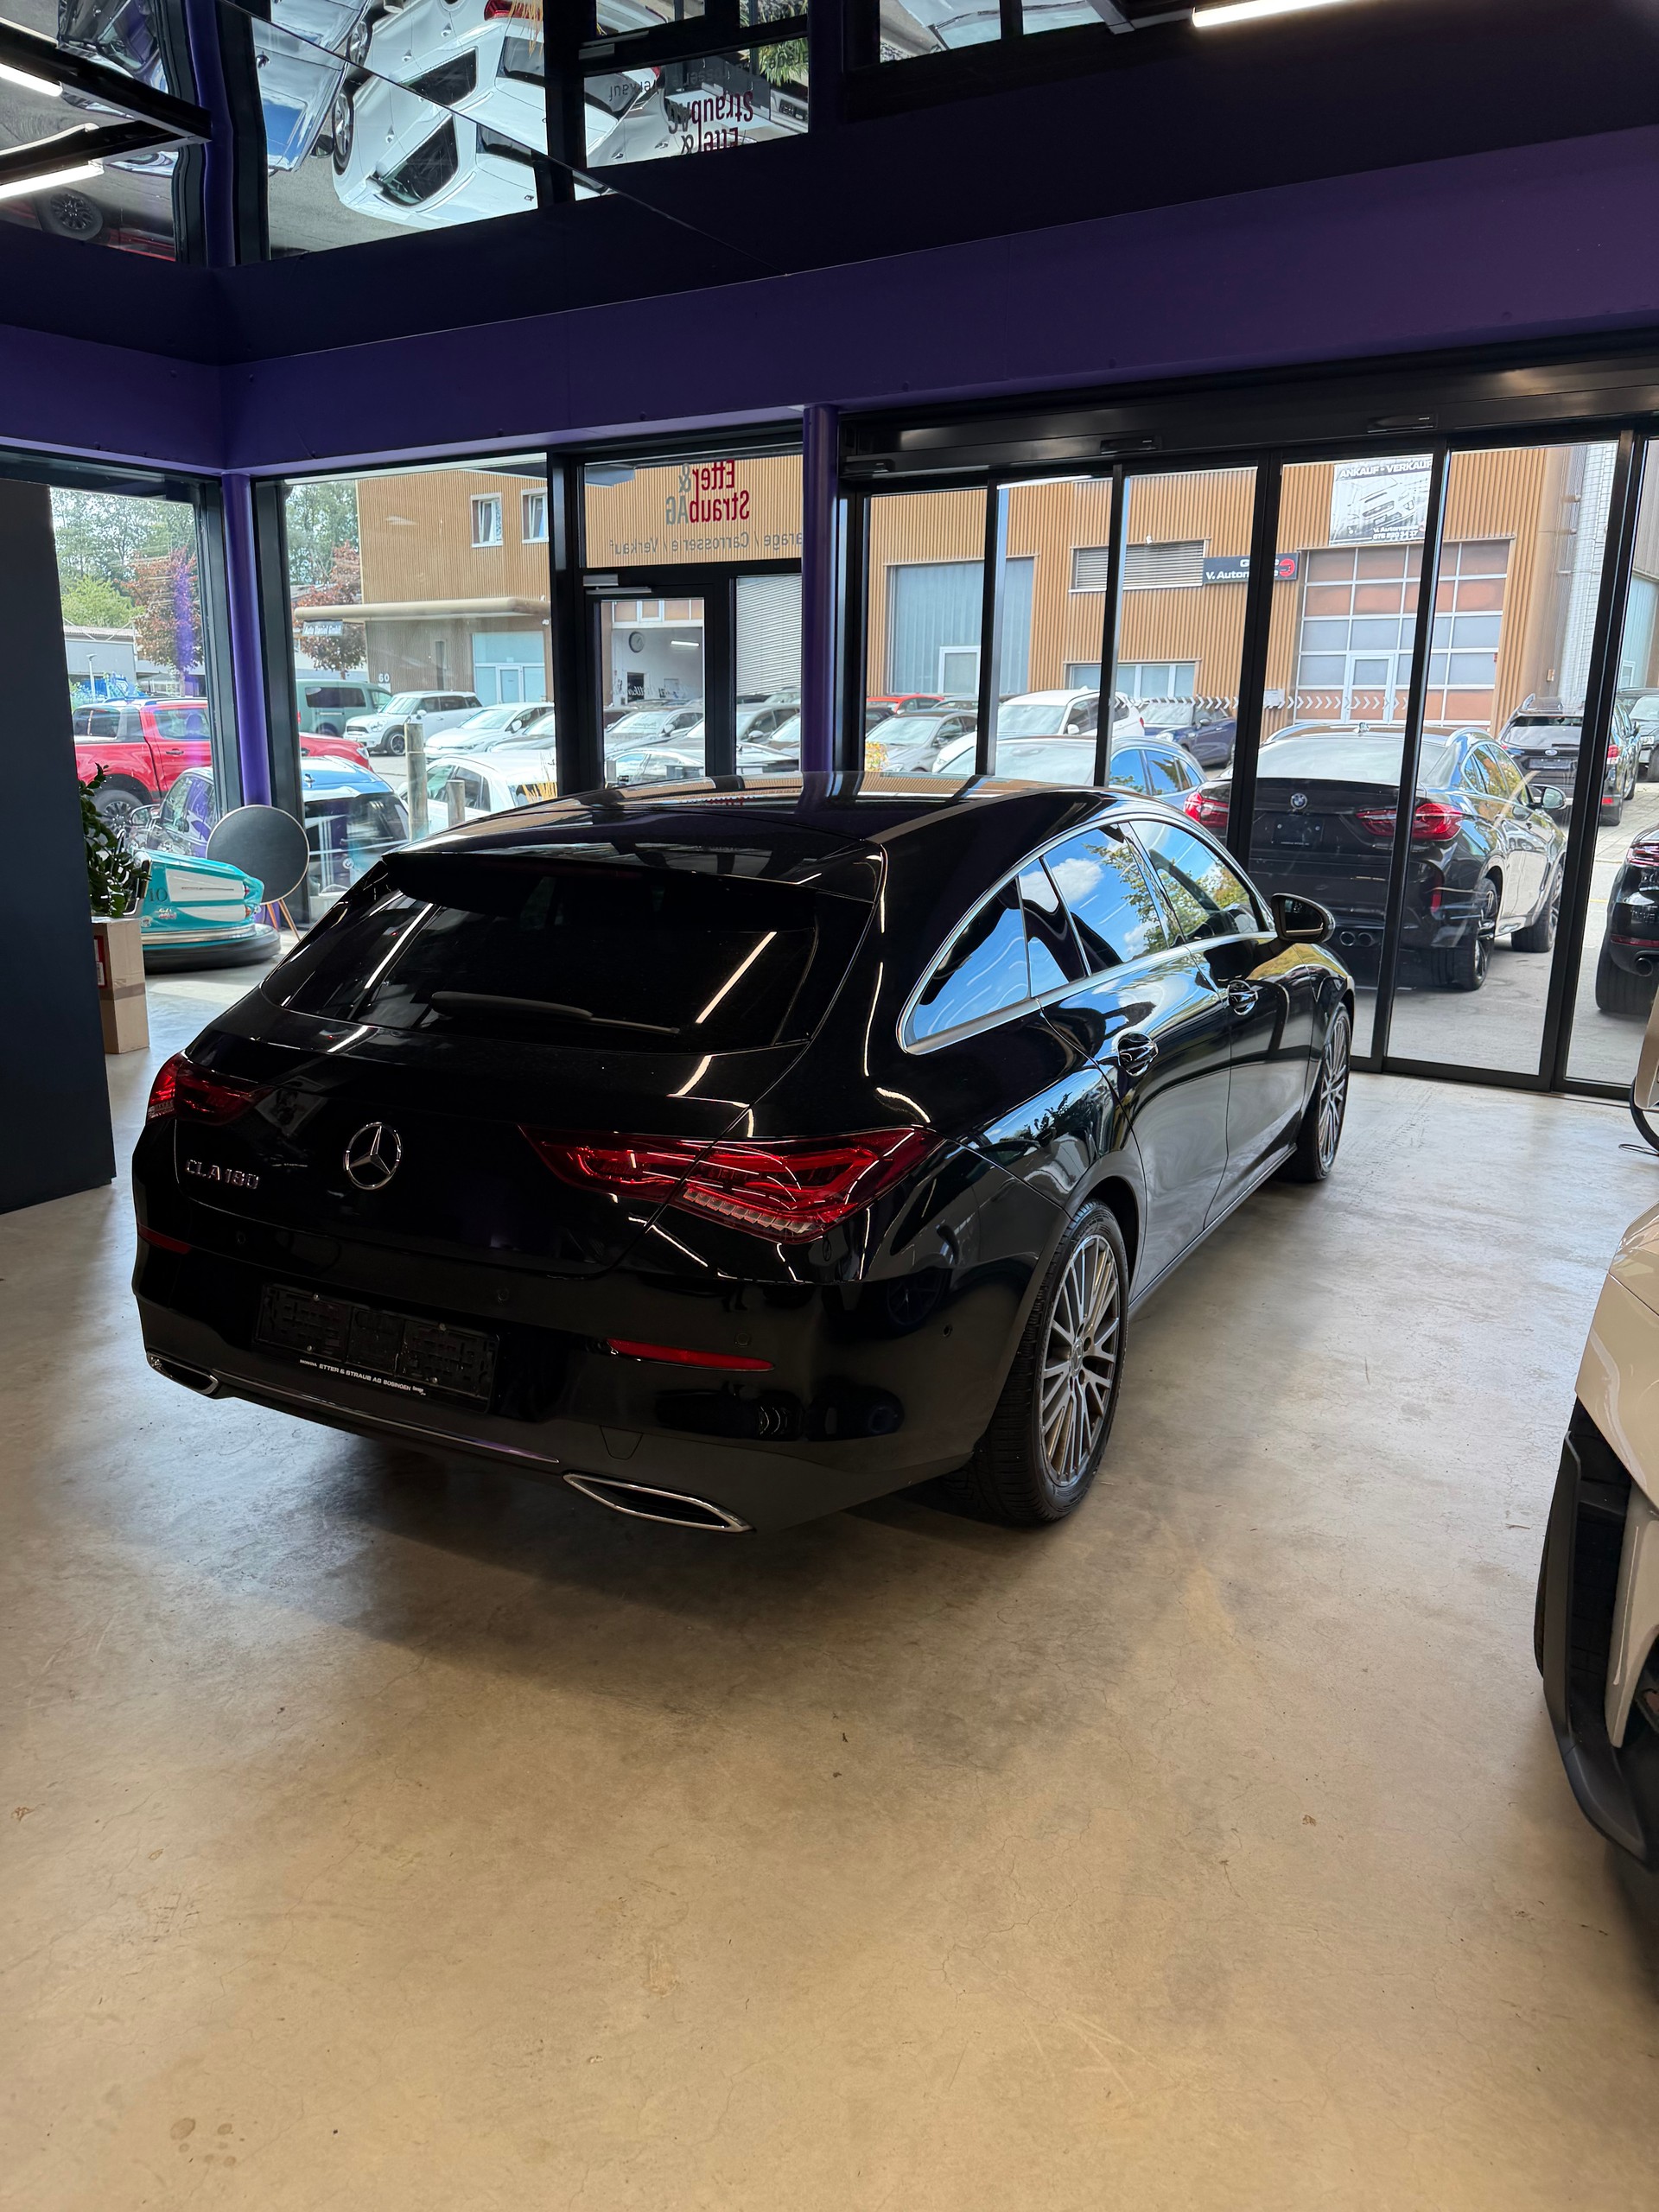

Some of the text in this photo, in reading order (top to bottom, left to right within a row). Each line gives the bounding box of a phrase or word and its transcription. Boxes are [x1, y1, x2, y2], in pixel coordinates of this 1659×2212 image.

[1339, 466, 1379, 478] ANKAUF
[378, 673, 390, 683] 60
[186, 1159, 259, 1190] CLA 180
[319, 1363, 340, 1373] ETTER
[346, 1370, 372, 1382] STRAUB
